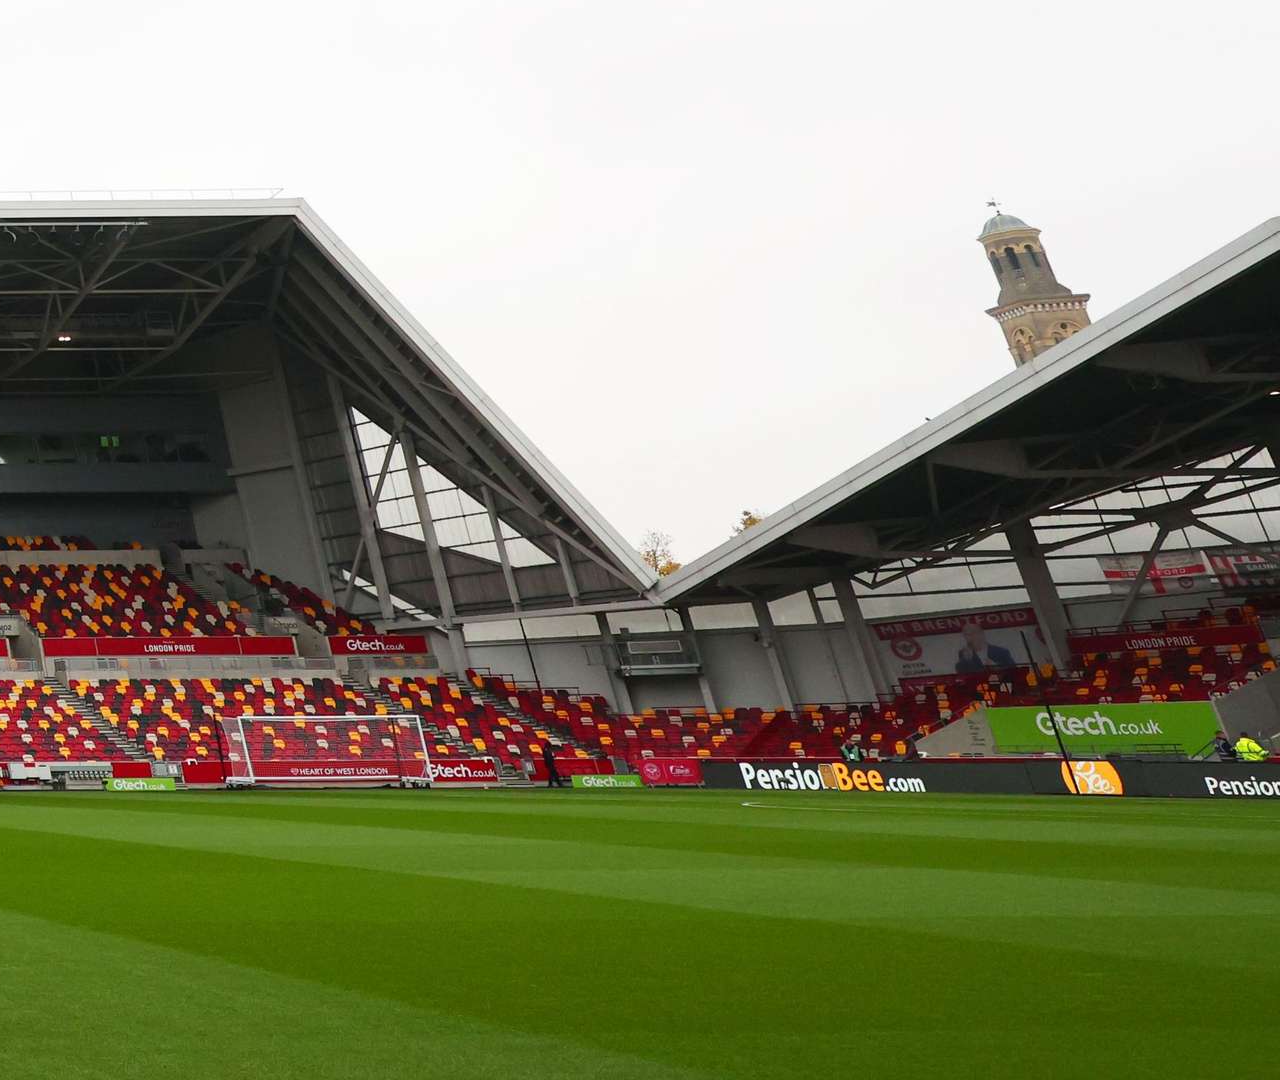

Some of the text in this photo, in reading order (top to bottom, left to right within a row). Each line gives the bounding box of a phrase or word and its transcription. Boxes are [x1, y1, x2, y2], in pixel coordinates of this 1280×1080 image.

[1120, 568, 1187, 577] BRETFORD
[880, 611, 1027, 635] MR BRENTFORD
[346, 639, 404, 651] Gtech.co.uk
[1125, 635, 1197, 650] LONDON PRIDE
[1035, 711, 1163, 735] Gtech.co.uk
[430, 764, 496, 778] Gtech.co.uk
